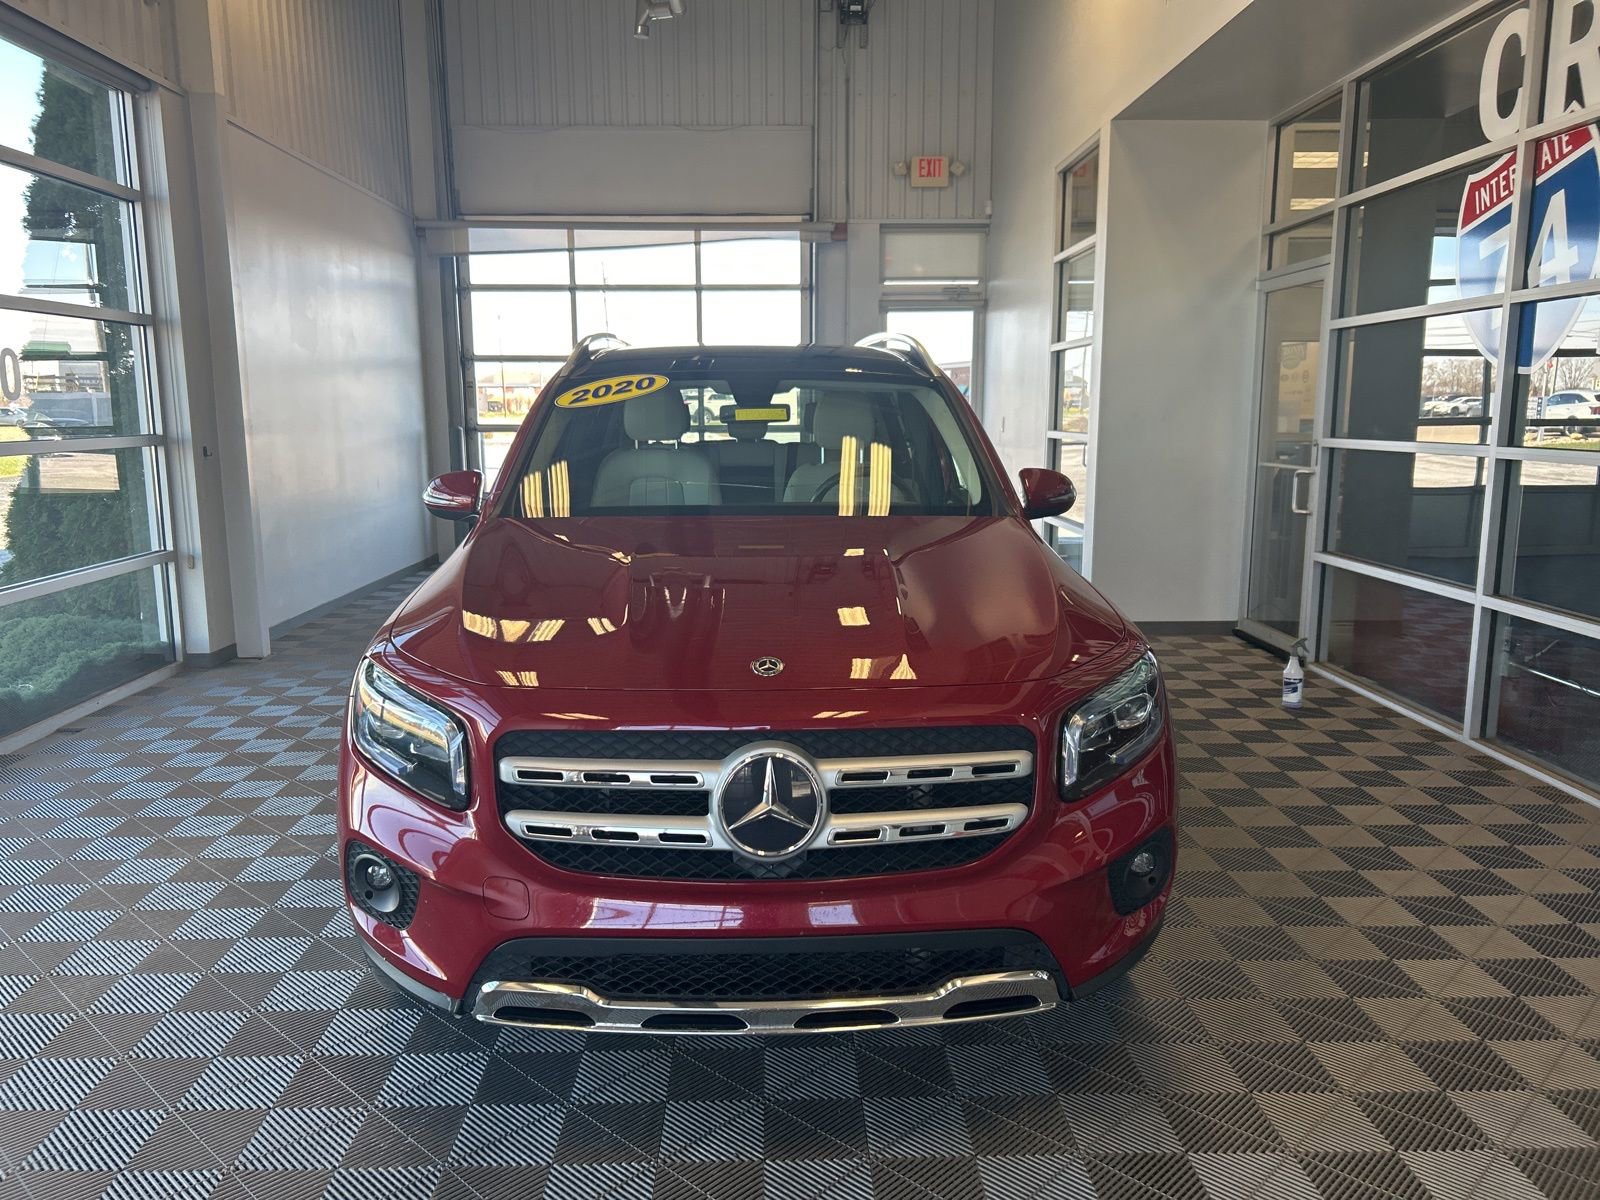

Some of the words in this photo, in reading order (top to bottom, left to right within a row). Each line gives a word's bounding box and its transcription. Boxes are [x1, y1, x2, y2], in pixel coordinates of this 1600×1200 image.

[917, 158, 944, 178] EXIT
[1475, 133, 1573, 215] INTEATE
[1479, 188, 1579, 330] 74
[568, 376, 656, 405] 2020
